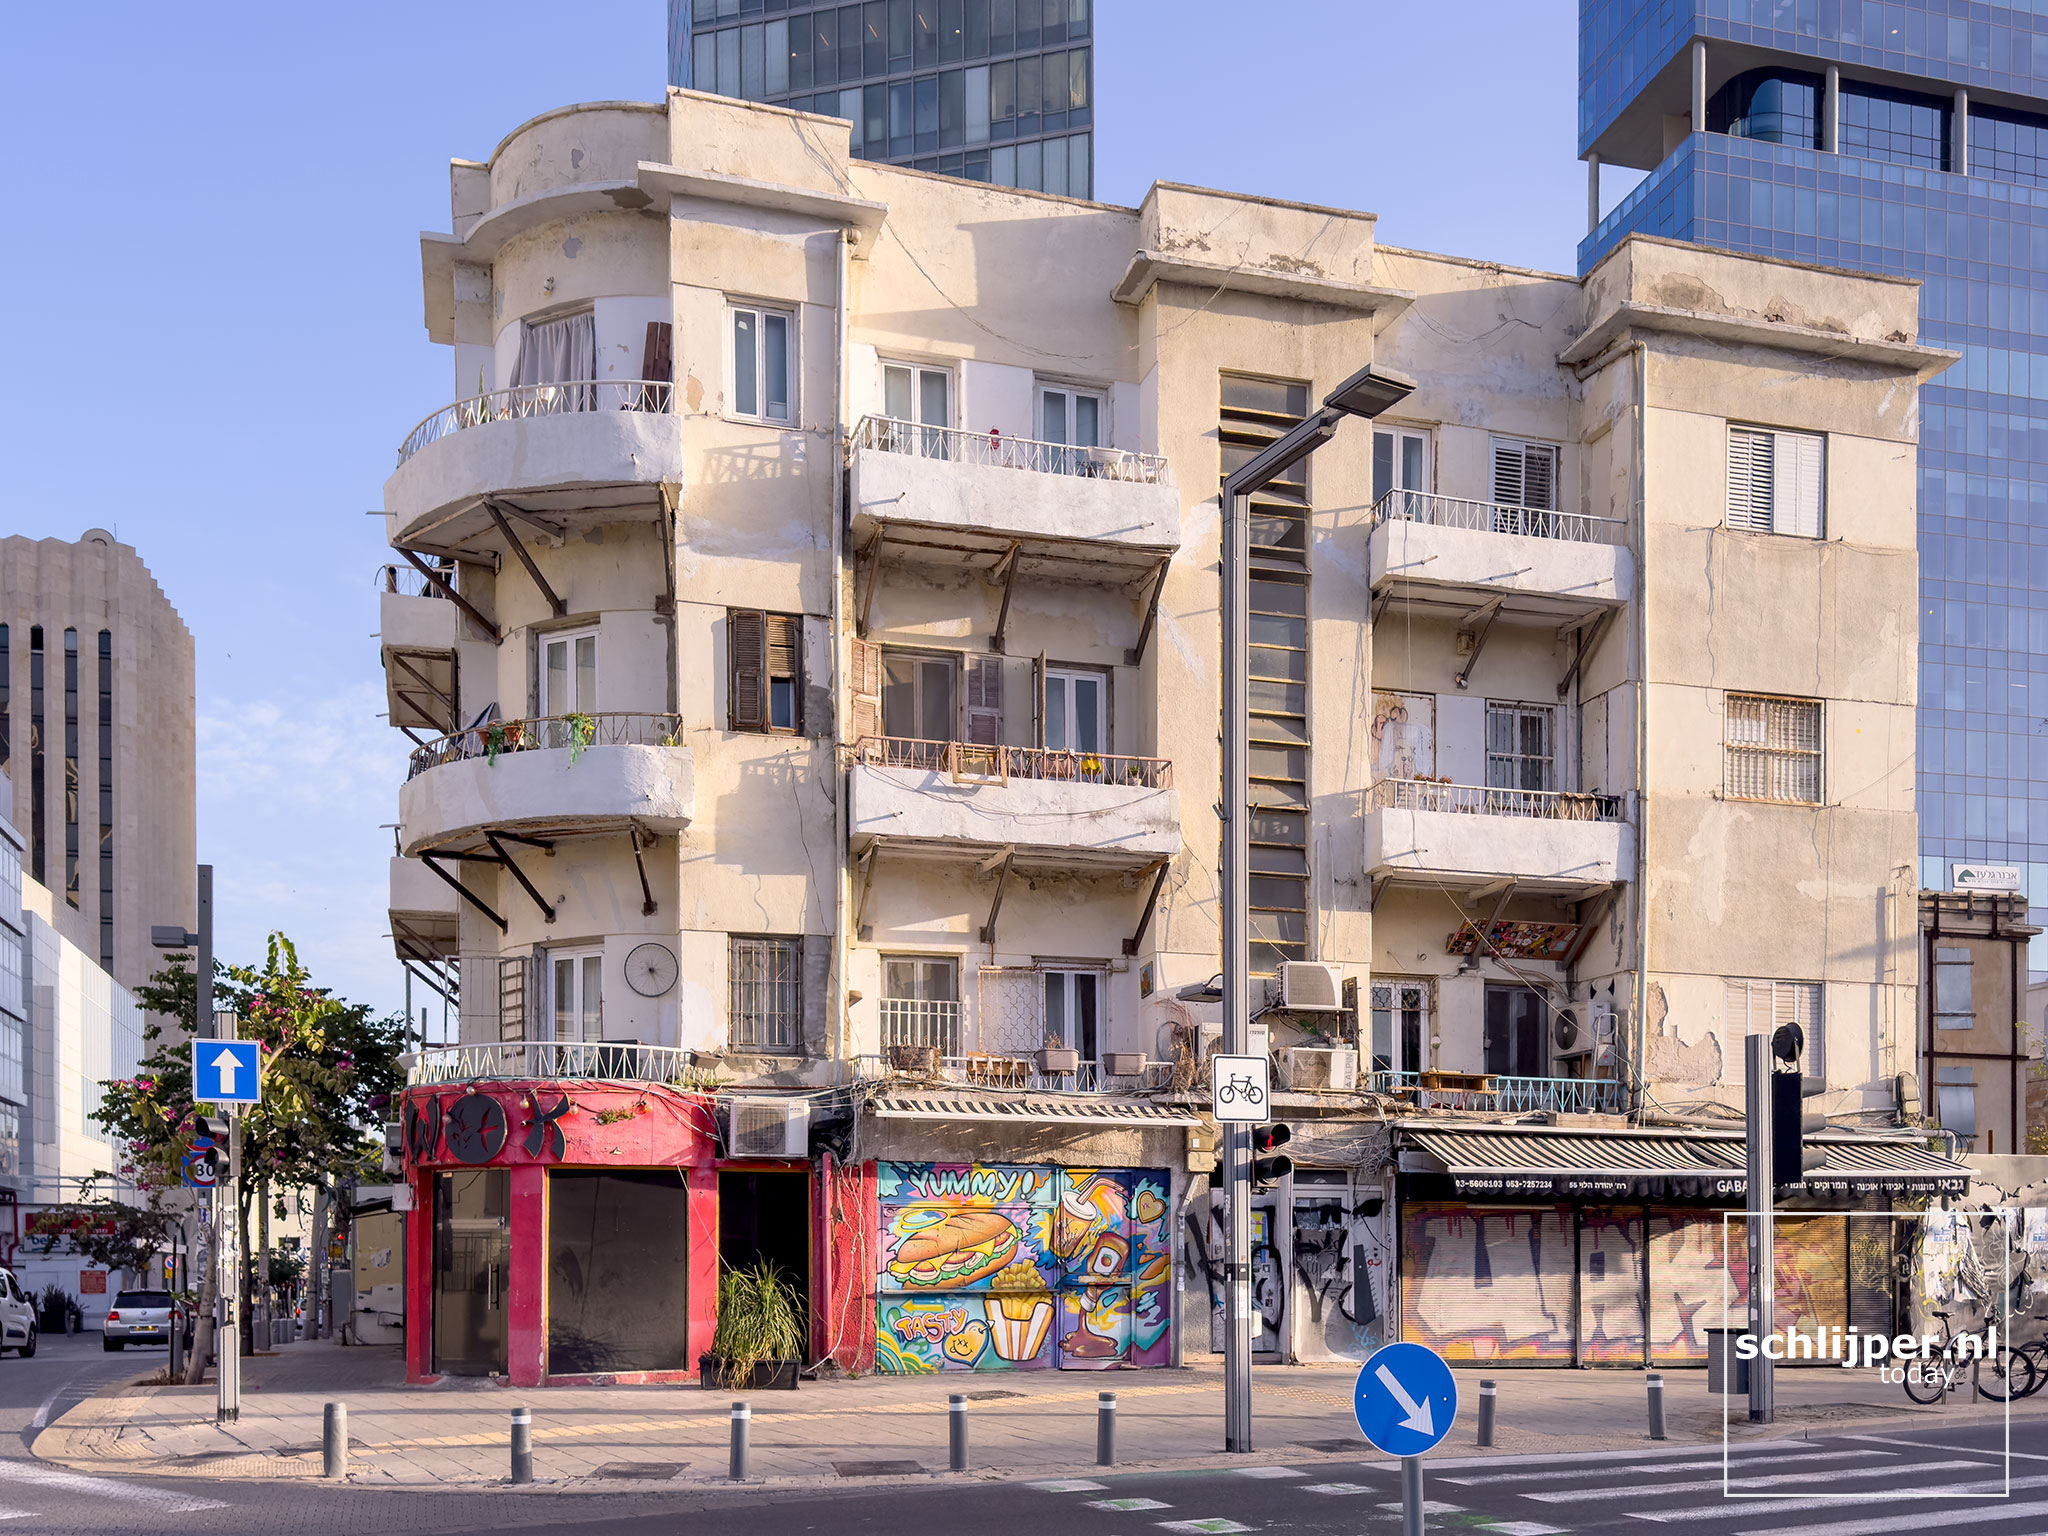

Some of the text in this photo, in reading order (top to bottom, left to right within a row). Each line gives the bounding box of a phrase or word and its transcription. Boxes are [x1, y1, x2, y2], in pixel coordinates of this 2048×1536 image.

[196, 1164, 215, 1177] 30
[909, 1169, 1035, 1200] YUMMY!
[1455, 1180, 1503, 1188] 03-5606103
[1579, 1181, 1593, 1189] הלוי
[1716, 1180, 1747, 1192] GABA
[1814, 1181, 1847, 1191] תמרוקים
[1856, 1182, 1879, 1191] אופנה
[1911, 1182, 1935, 1191] מתנות
[1937, 1179, 1965, 1190] גבאי
[894, 1307, 969, 1344] TASTY
